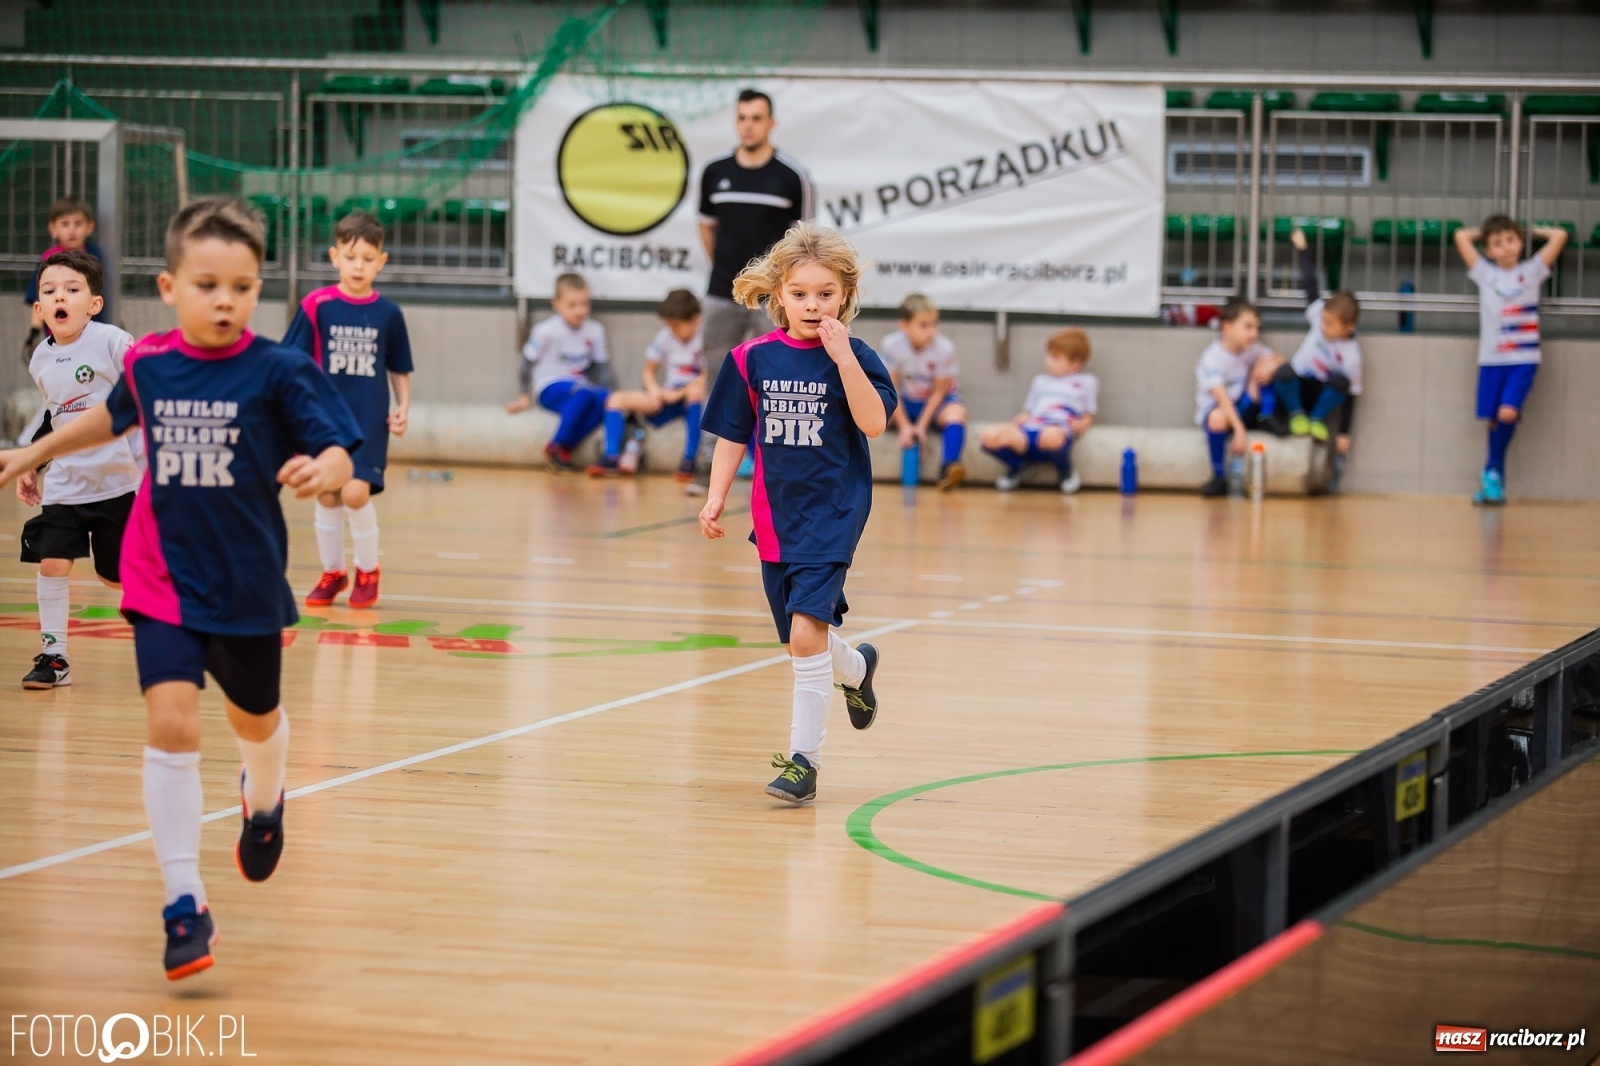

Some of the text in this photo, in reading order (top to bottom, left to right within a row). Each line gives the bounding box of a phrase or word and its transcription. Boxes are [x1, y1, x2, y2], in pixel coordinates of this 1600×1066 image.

[826, 119, 1127, 227] W PORZĄDKU!
[553, 243, 692, 271] RACIBÓRZ
[876, 258, 1128, 285] www.osir-raciborz.pl
[329, 352, 377, 377] PIK
[763, 380, 827, 395] PAWILON
[154, 400, 238, 418] PAWILON
[764, 418, 824, 446] PIK
[156, 451, 235, 487] PIK
